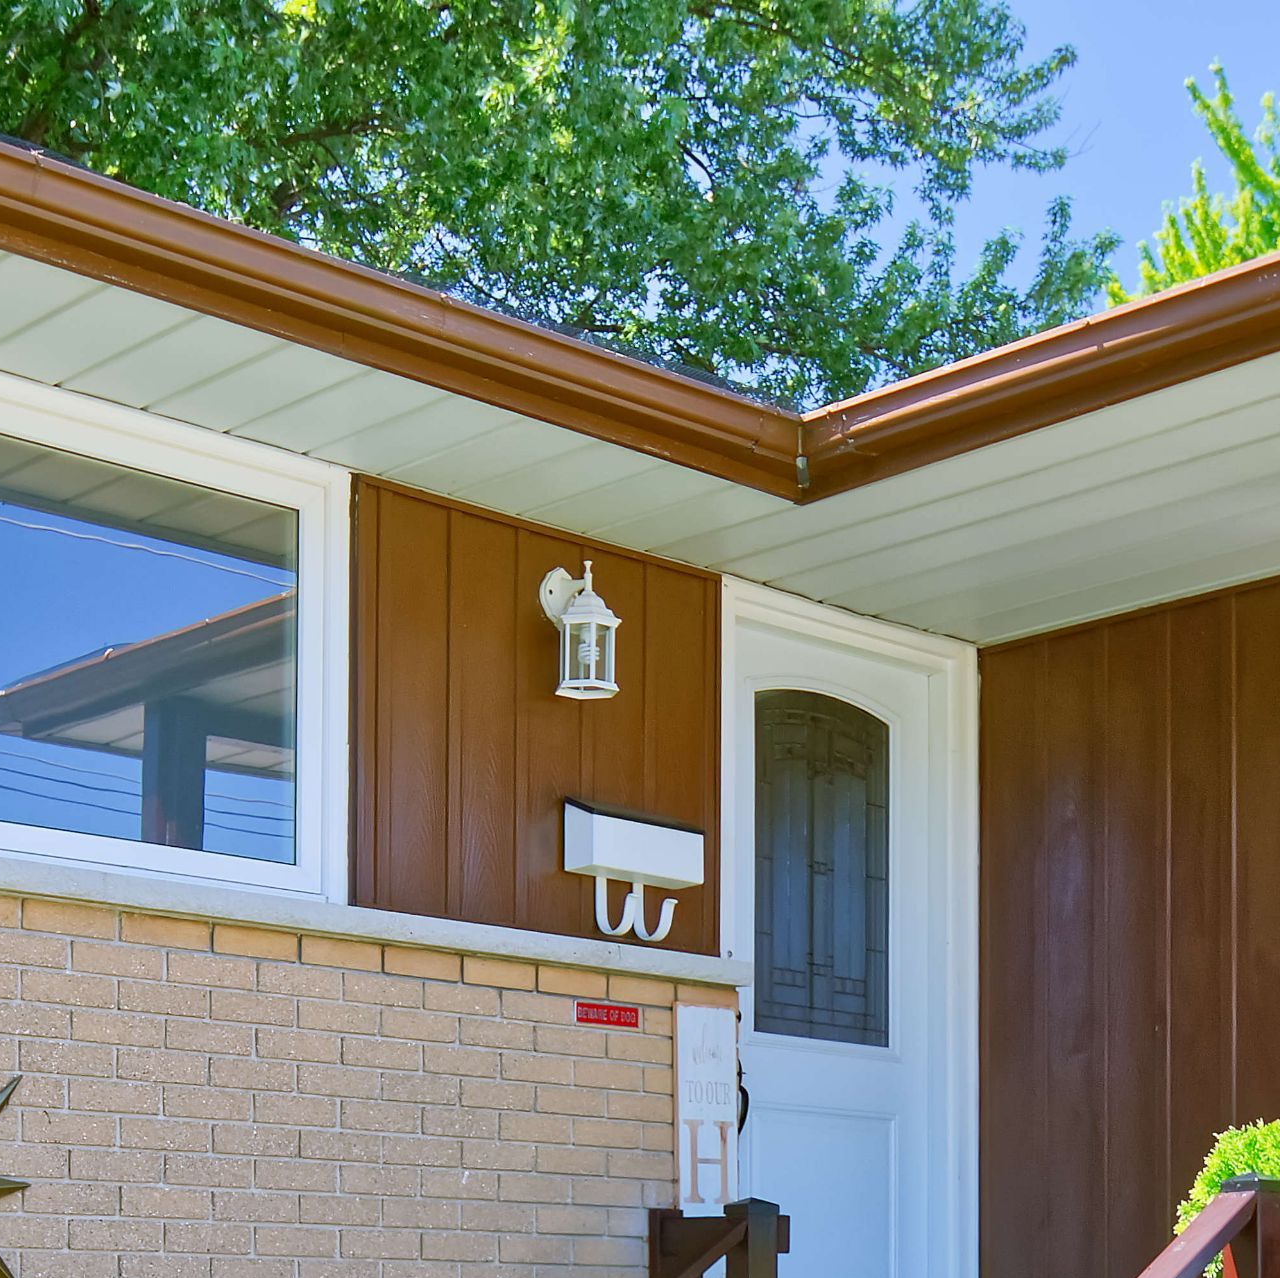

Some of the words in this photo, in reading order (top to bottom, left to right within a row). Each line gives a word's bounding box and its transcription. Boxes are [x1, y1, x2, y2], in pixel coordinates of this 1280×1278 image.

[577, 1006, 608, 1021] BEWARE
[609, 1009, 619, 1022] OF
[620, 1011, 636, 1023] DOG
[685, 1079, 704, 1104] TO
[705, 1080, 731, 1105] OUR
